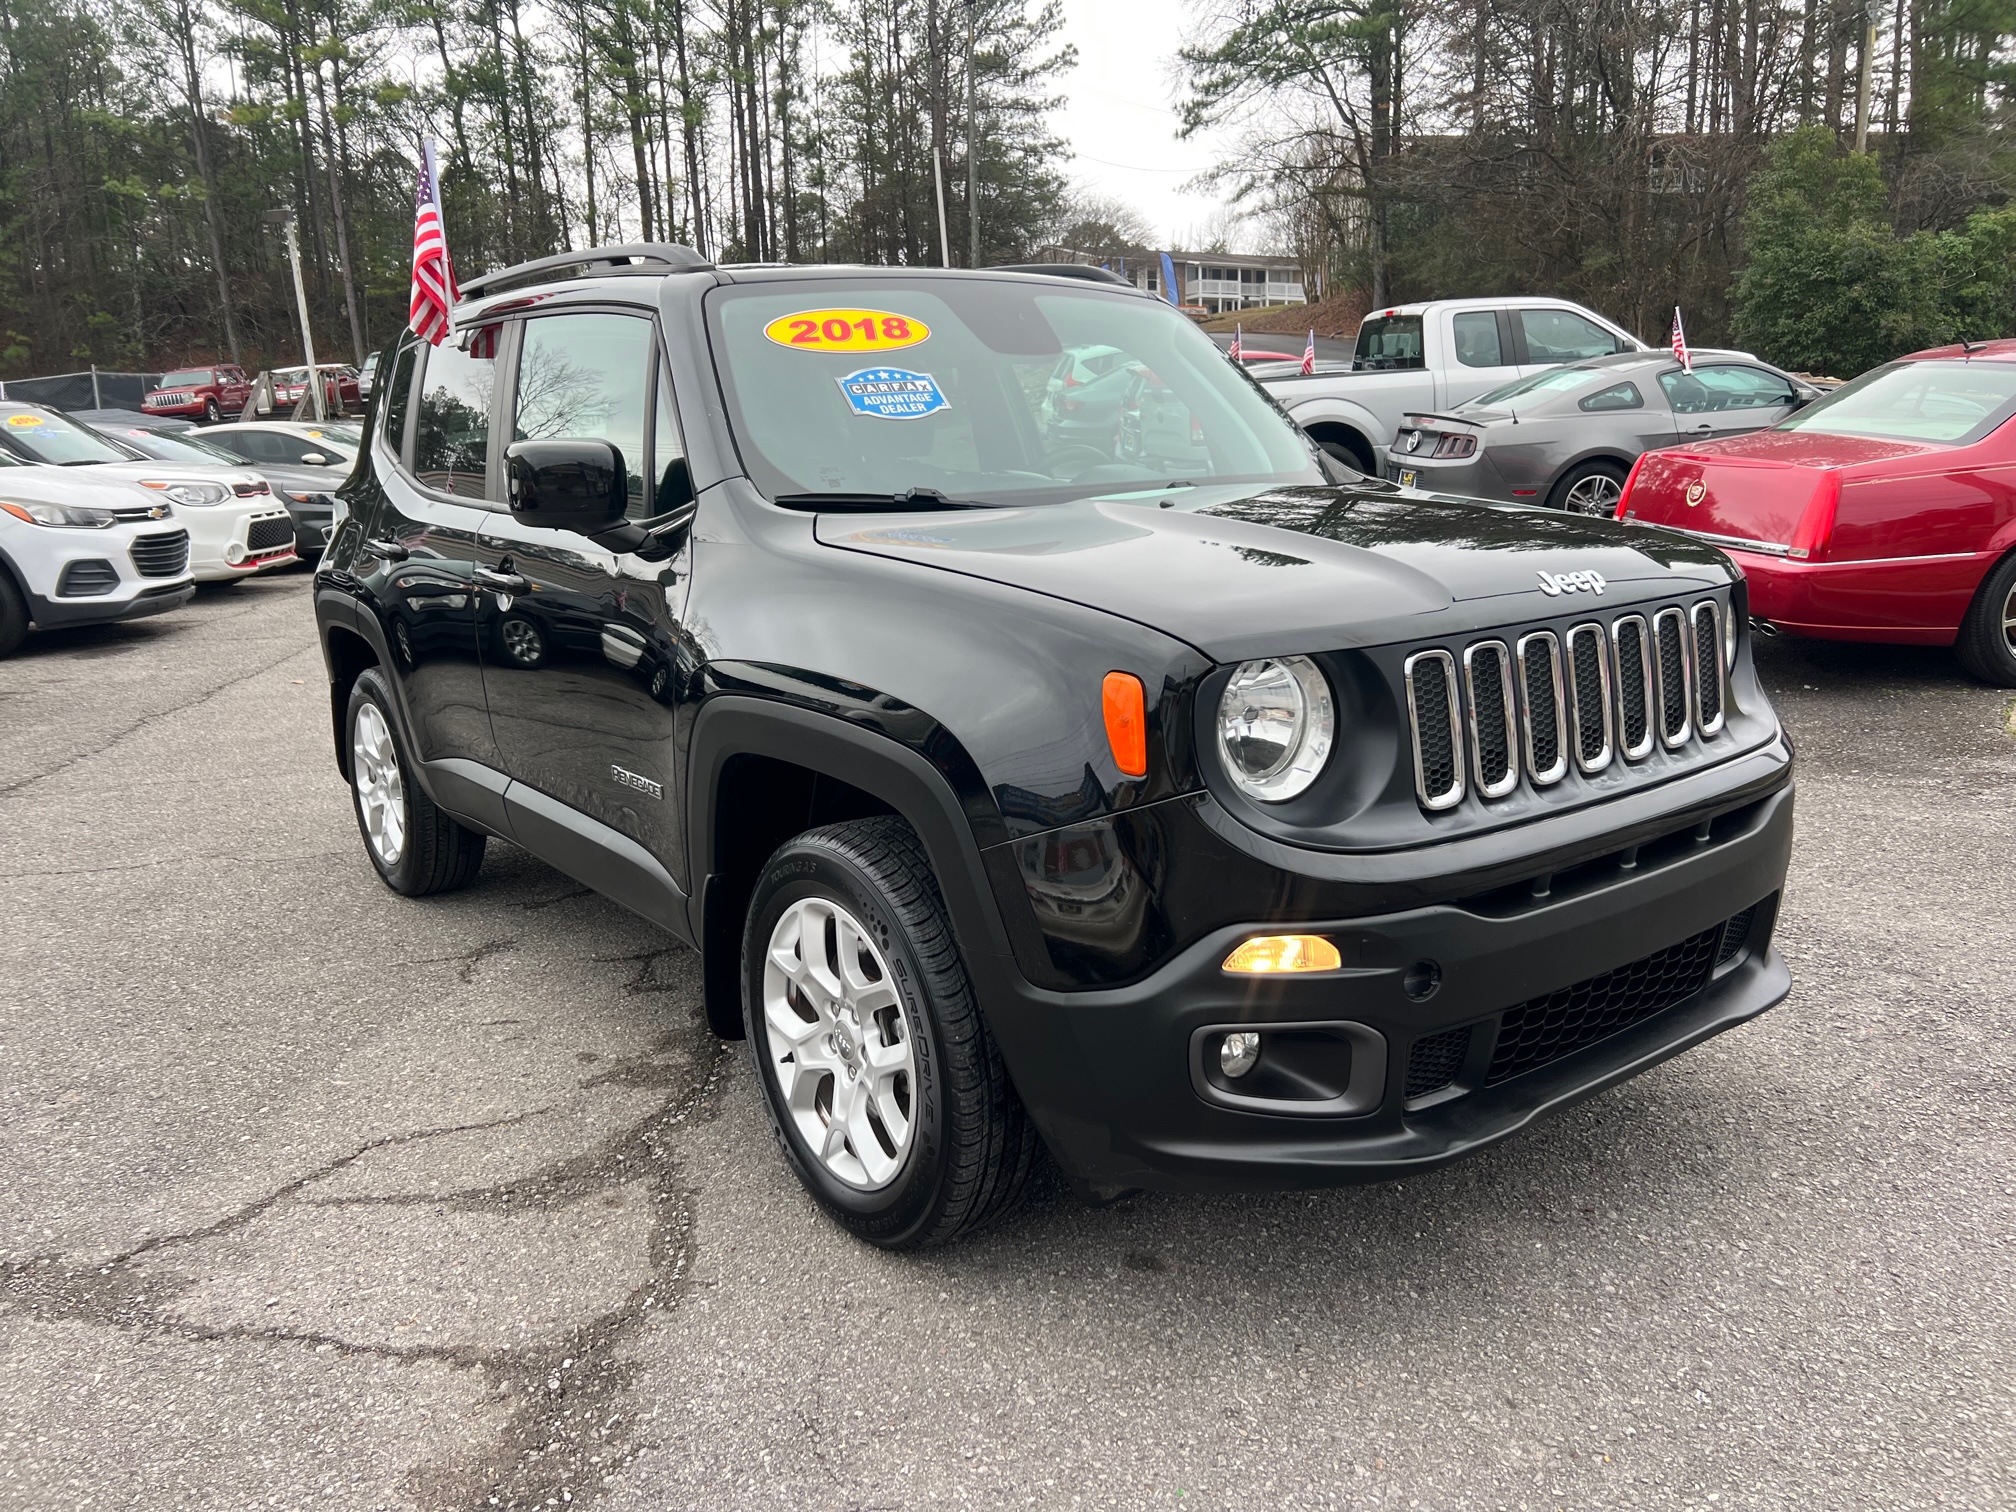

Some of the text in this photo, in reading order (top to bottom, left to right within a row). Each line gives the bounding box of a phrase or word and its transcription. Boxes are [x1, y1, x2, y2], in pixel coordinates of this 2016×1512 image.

[789, 317, 912, 344] 2018
[850, 382, 932, 394] CARFAX
[863, 393, 932, 405] ADVANTAGE
[879, 403, 927, 414] DEALER
[1536, 569, 1607, 597] Jeep
[611, 764, 665, 800] RENEGADE
[892, 957, 934, 1125] SUREDRIVE
